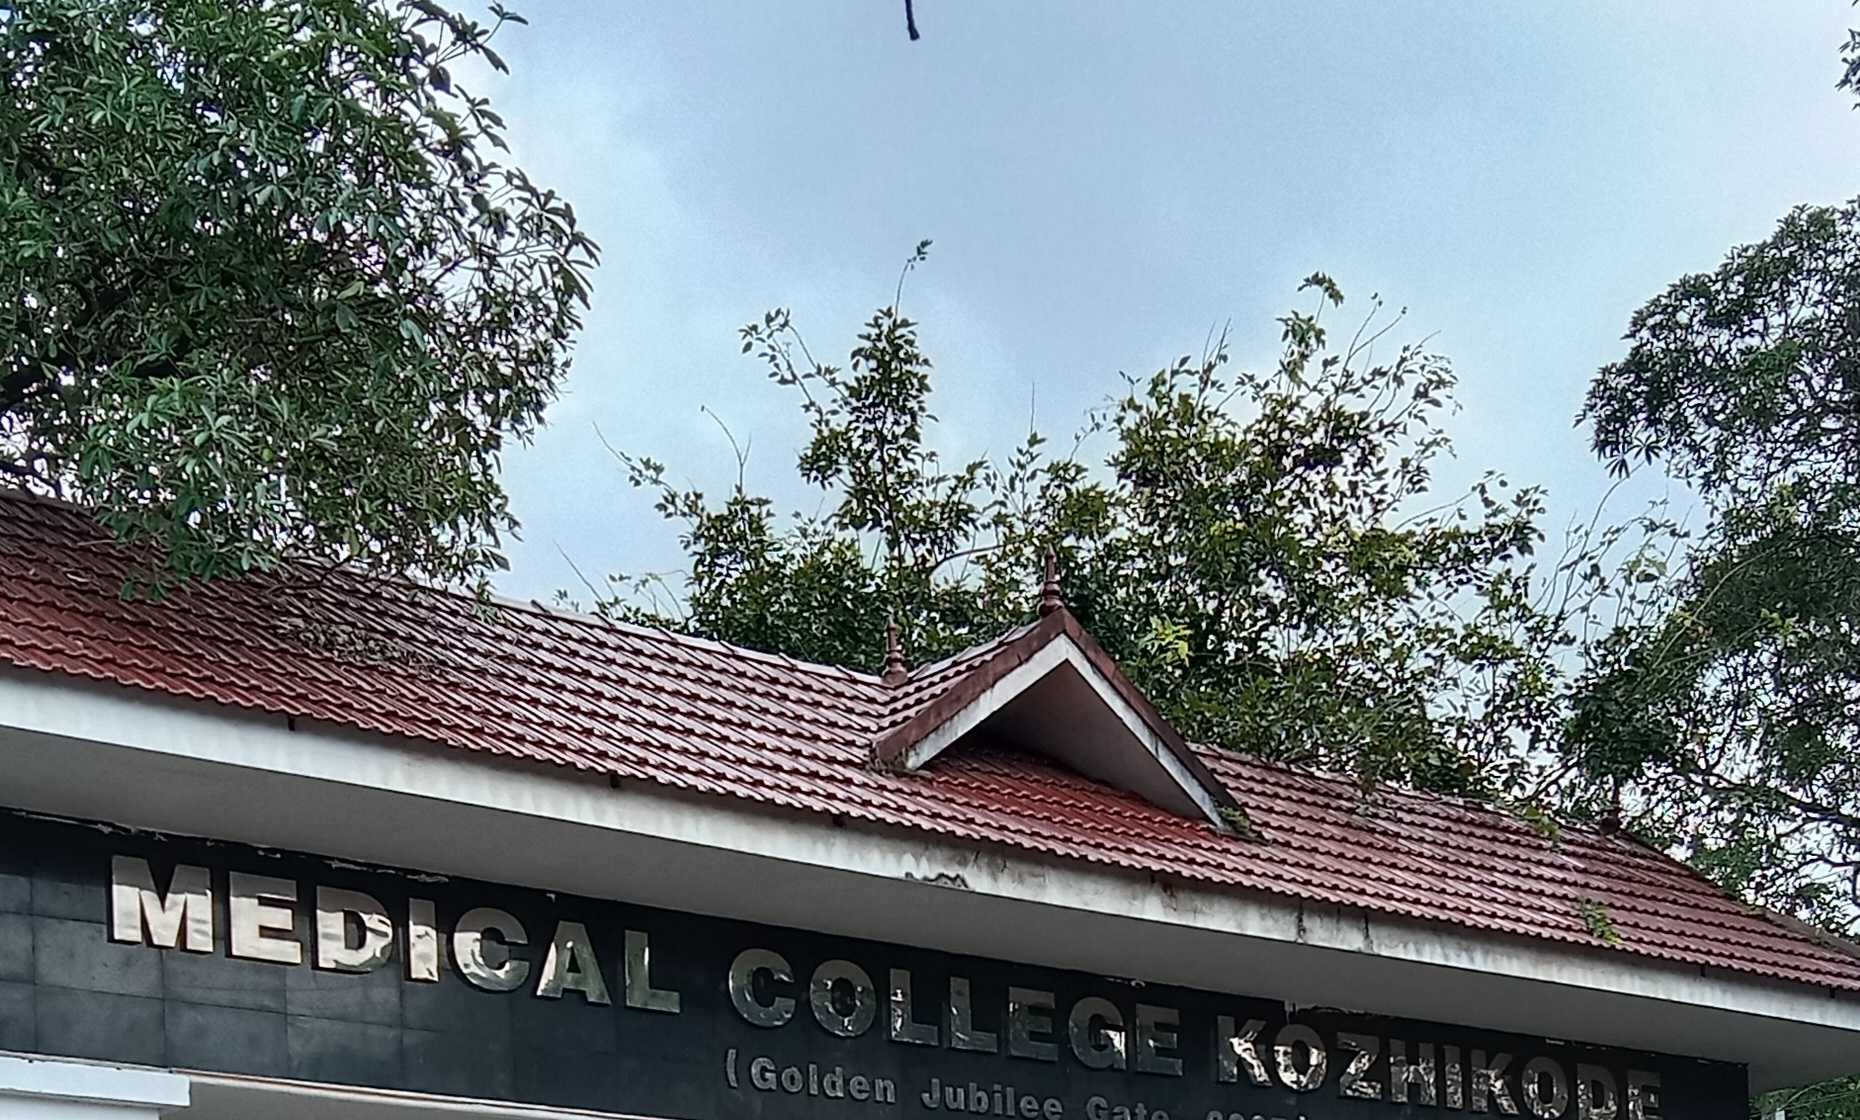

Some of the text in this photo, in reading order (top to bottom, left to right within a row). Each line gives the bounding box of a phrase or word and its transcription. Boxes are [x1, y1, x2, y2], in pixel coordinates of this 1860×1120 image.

[111, 854, 681, 1014] MEDICAL
[729, 948, 1184, 1077] COLLEGE
[726, 1048, 896, 1104] (Golden
